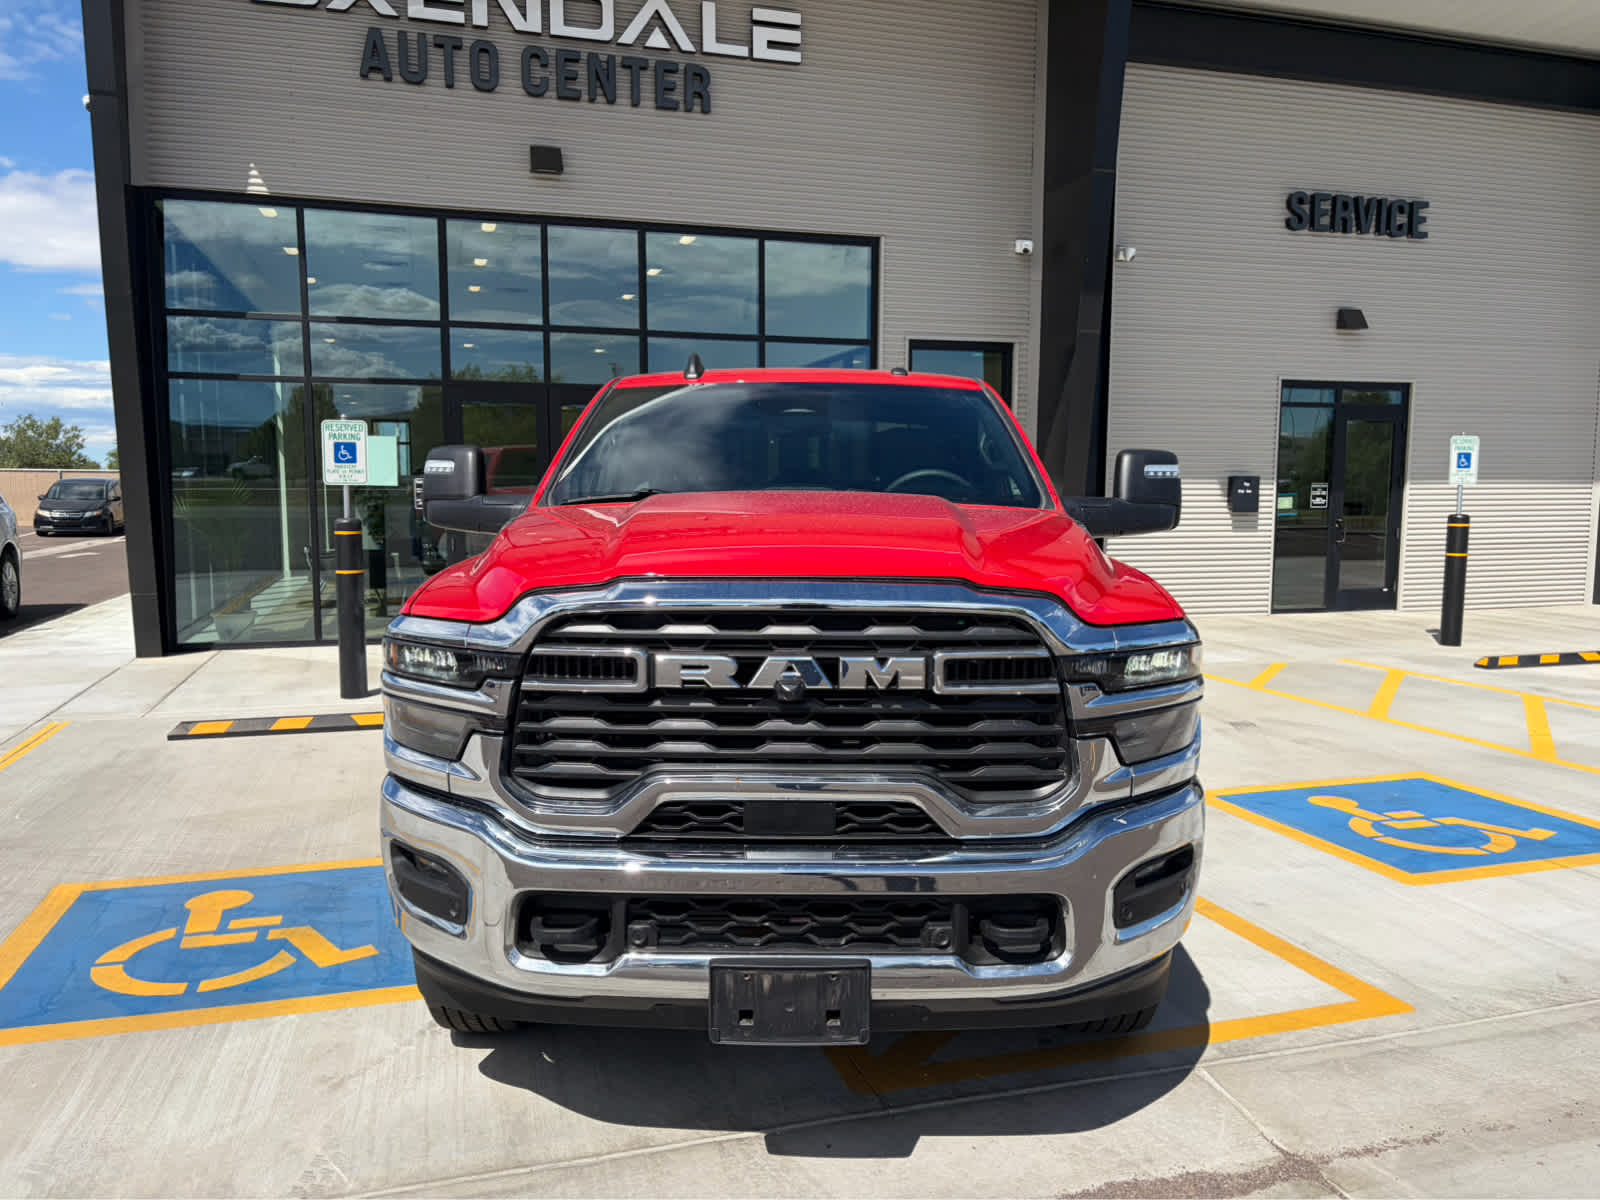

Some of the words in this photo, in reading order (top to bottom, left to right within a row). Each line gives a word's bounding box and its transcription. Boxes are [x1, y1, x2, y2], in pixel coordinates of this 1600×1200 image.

[248, 0, 801, 63] NDALE
[360, 27, 500, 92] AUTO
[520, 45, 711, 114] CENTER
[1285, 191, 1429, 239] SERVICE
[324, 423, 363, 432] RESERVED
[328, 432, 361, 441] PARKING
[655, 655, 925, 689] RAM
